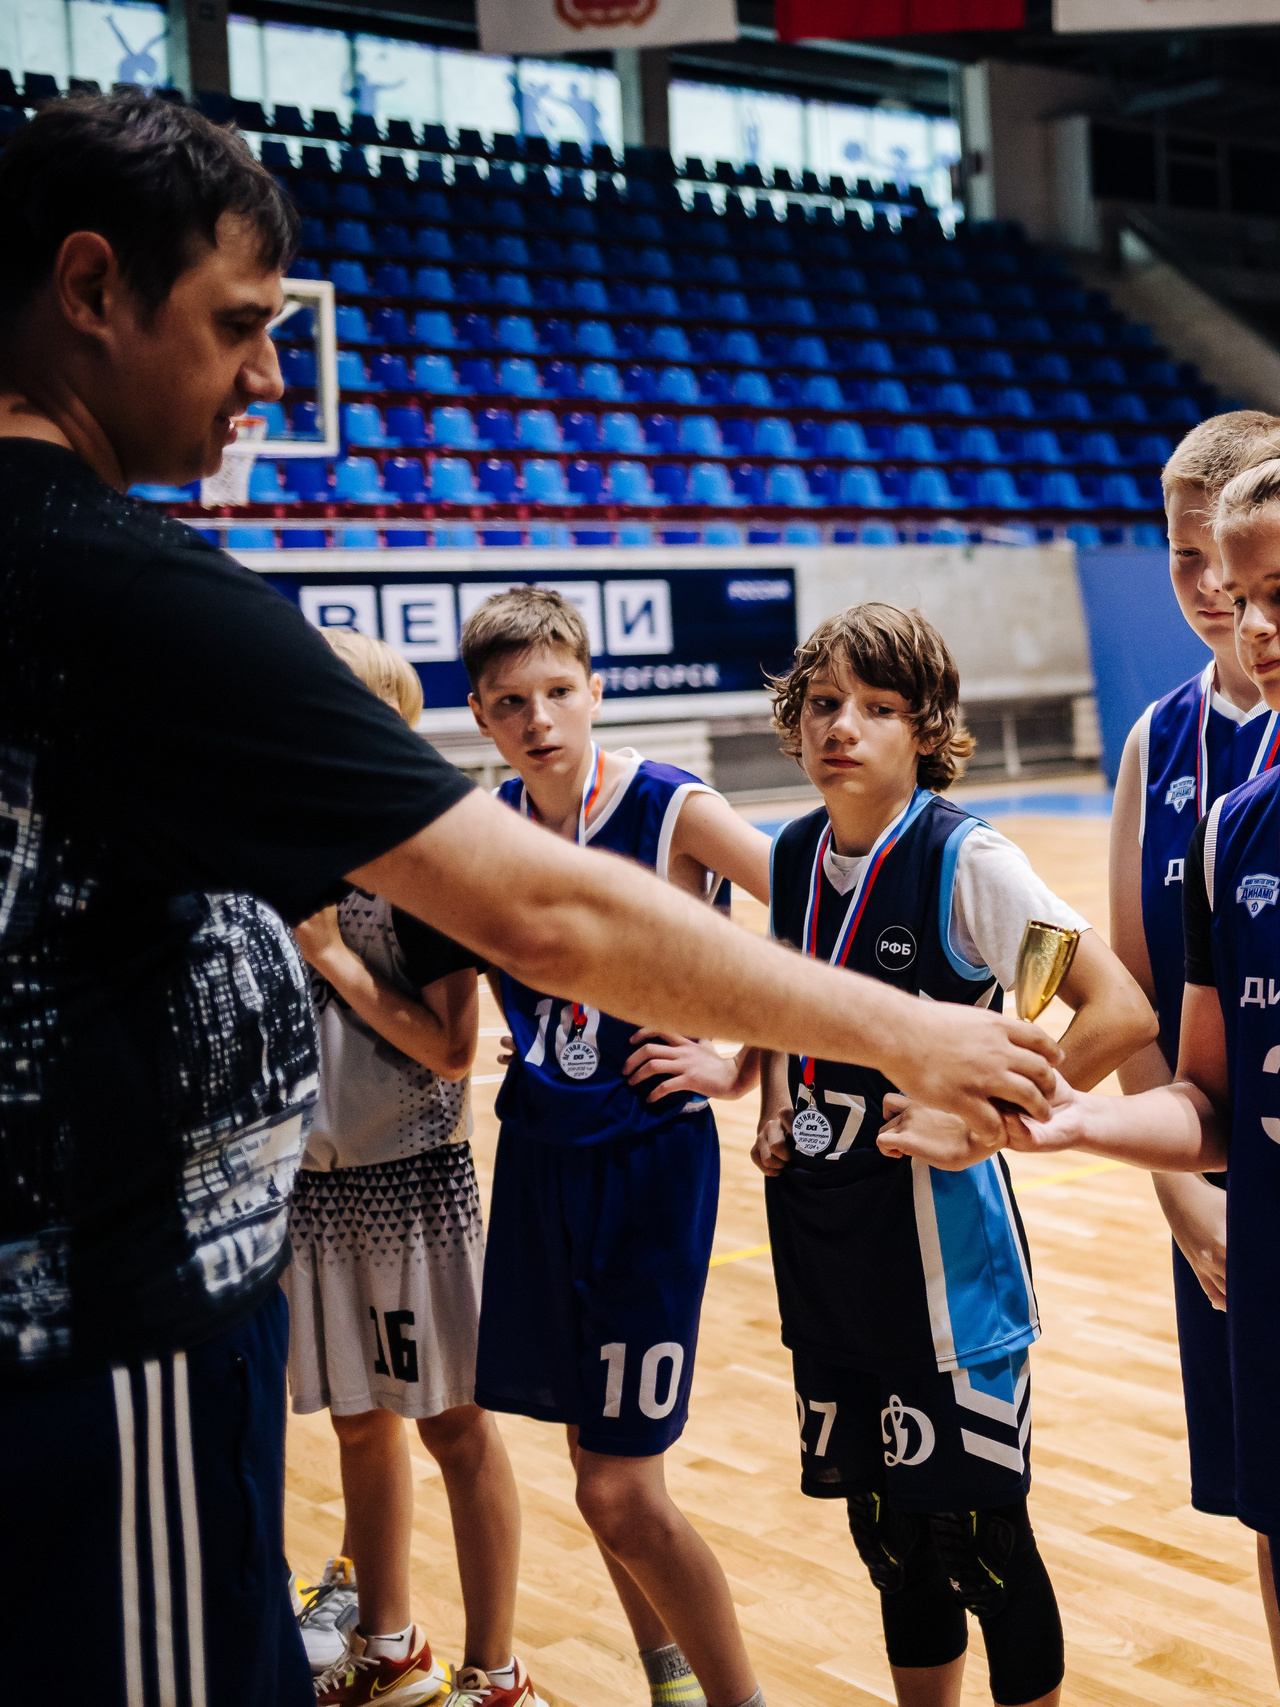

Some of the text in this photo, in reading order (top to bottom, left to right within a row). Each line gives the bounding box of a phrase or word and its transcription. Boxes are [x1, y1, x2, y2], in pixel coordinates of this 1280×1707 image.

[318, 598, 656, 643] ВЕИ
[1241, 887, 1274, 900] ДИНАМО
[880, 941, 912, 956] РФБ
[795, 1113, 816, 1129] ЛЕТНЯЯ
[816, 1116, 829, 1132] ЛИГА
[370, 1306, 419, 1383] 16
[600, 1342, 684, 1419] 10
